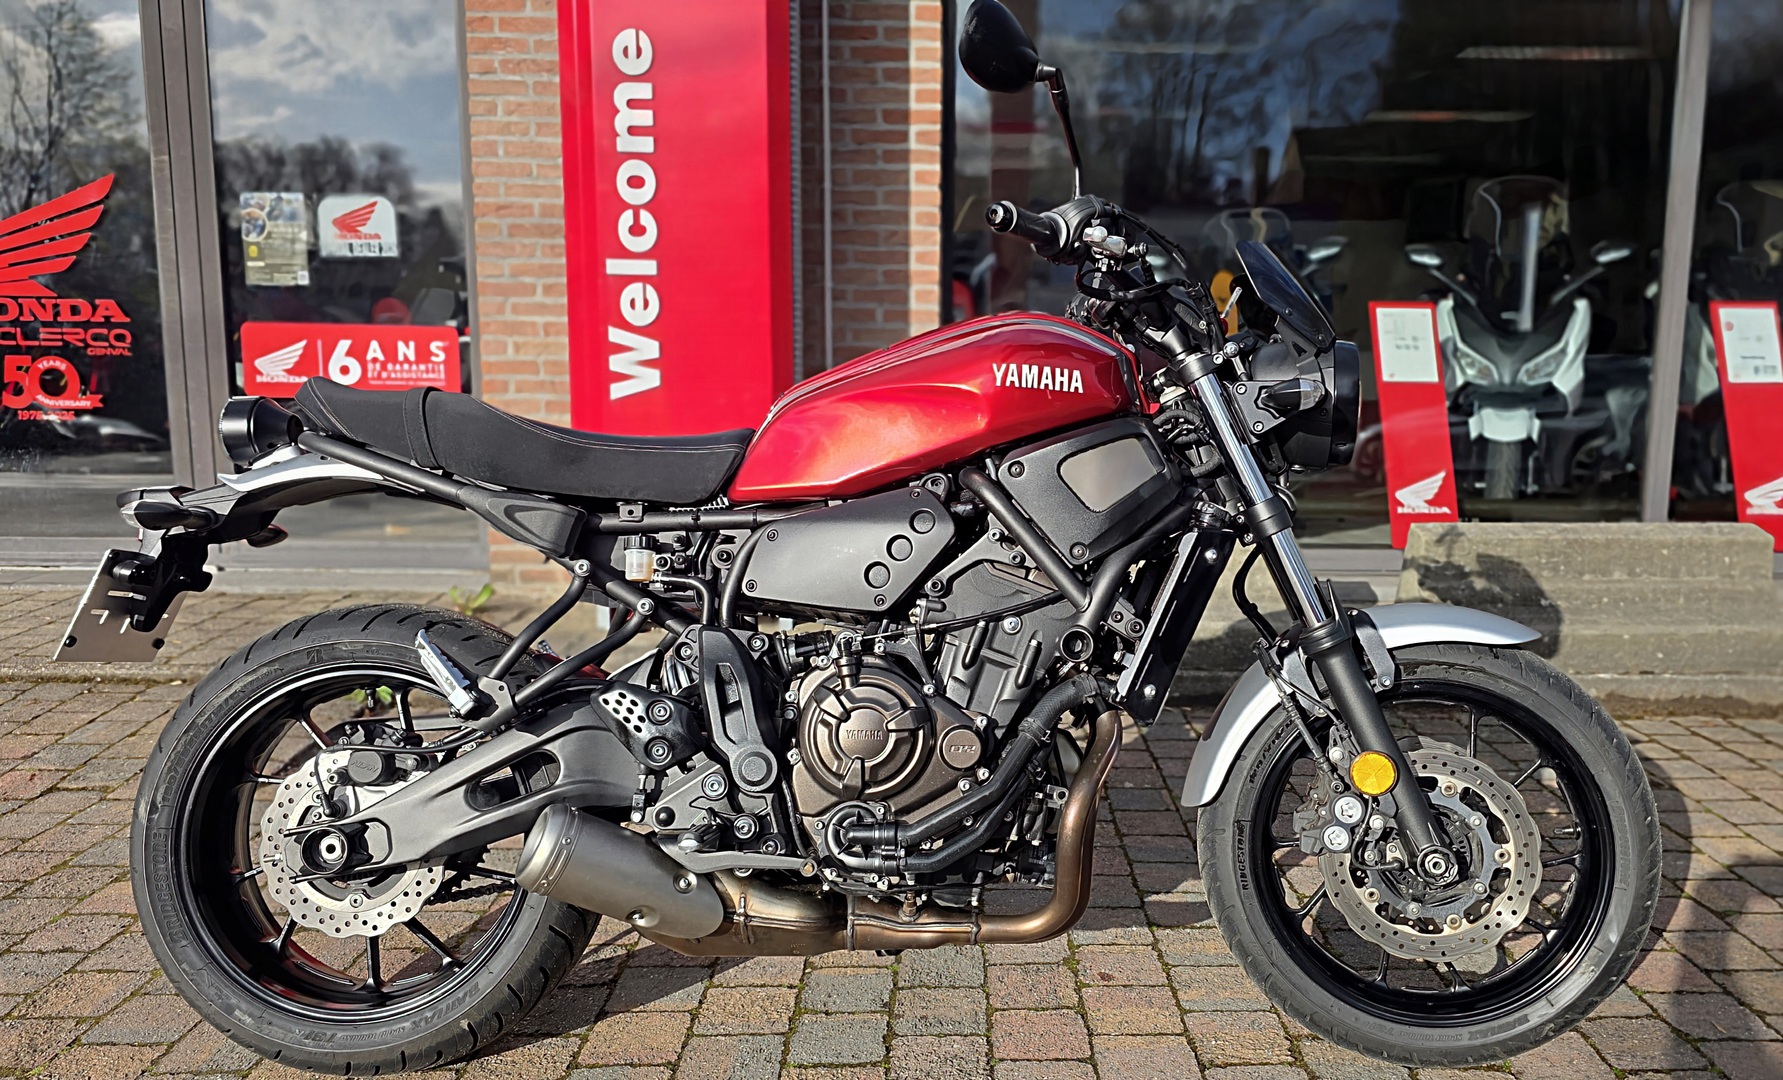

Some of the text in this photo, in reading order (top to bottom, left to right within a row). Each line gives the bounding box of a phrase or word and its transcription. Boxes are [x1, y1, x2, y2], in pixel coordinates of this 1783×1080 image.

[606, 28, 660, 400] Welcome
[37, 359, 67, 371] YEARS
[87, 348, 133, 356] GENVAL
[328, 339, 446, 386] 6 ANS
[2, 355, 81, 409] 50
[992, 363, 1084, 394] YAMAHA
[35, 394, 92, 408] ANNIVERSARY
[846, 729, 883, 740] YAMAHA
[151, 830, 189, 944] BRIDGESTONE
[409, 981, 481, 1031] BATTLAX
